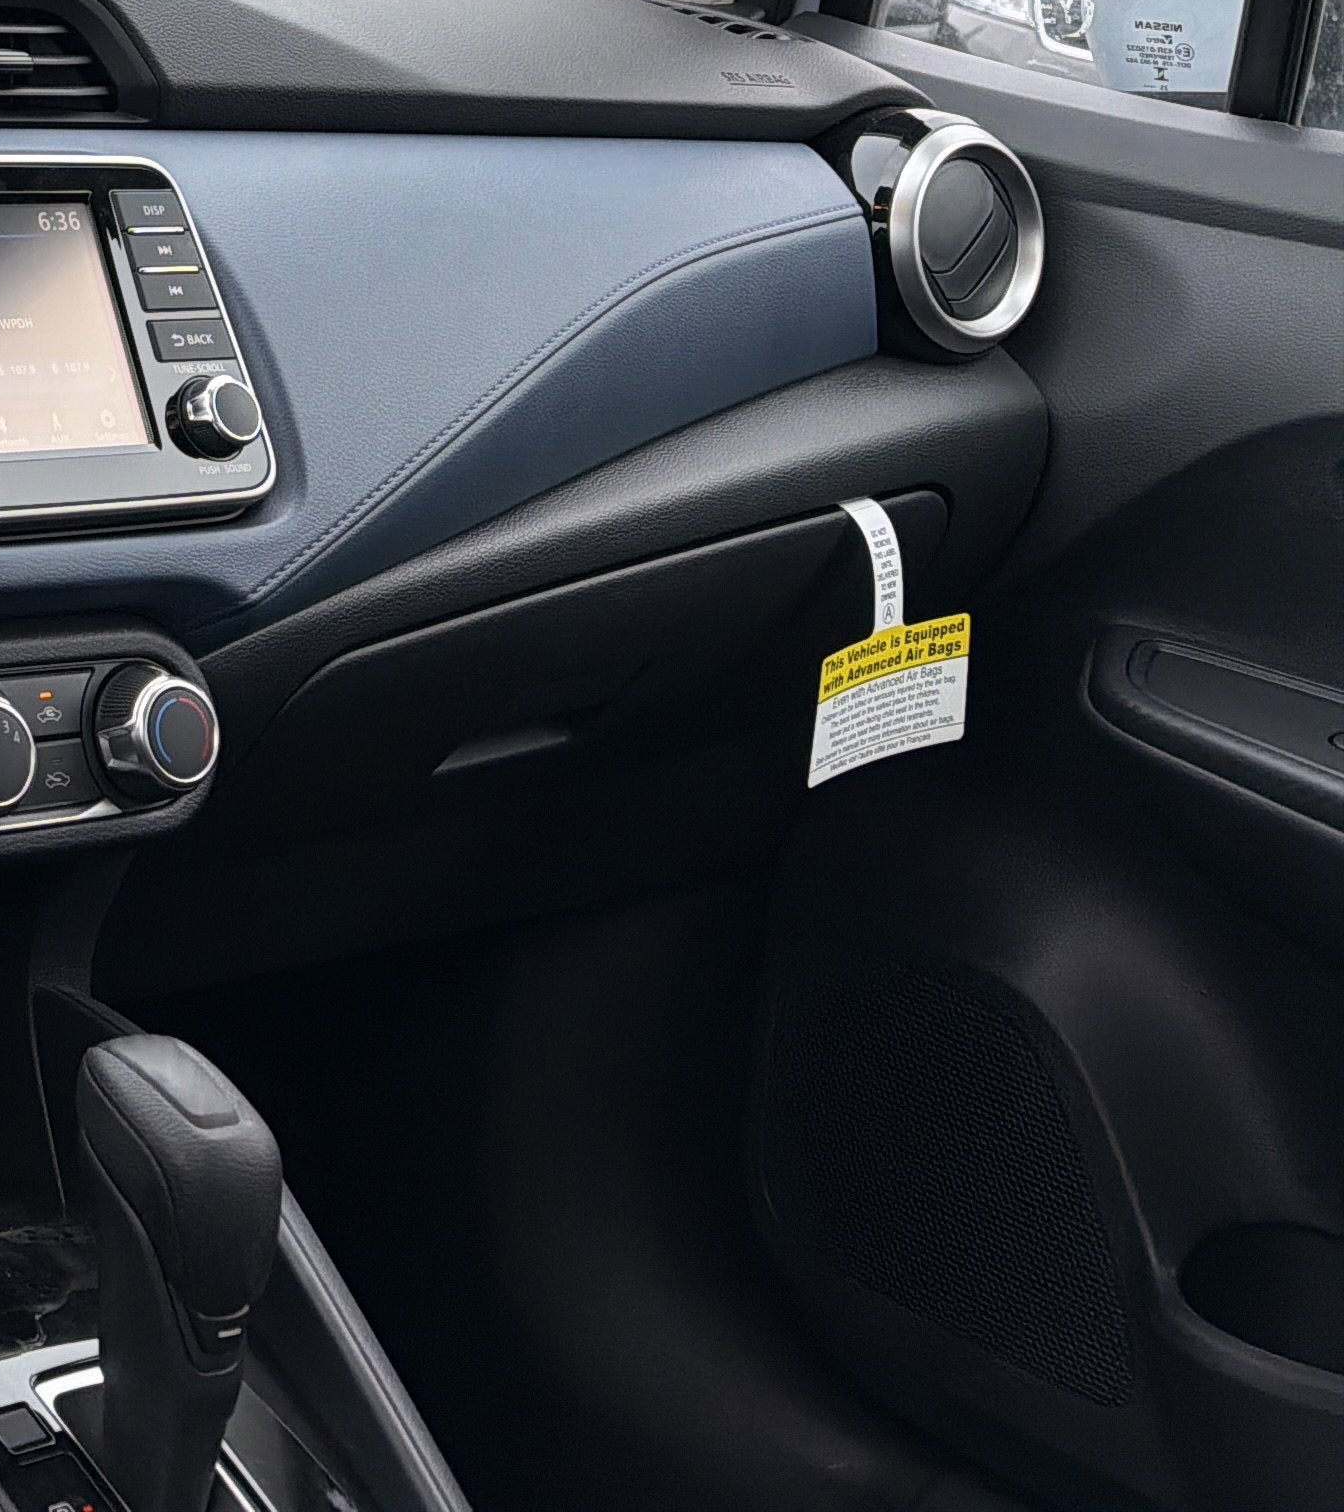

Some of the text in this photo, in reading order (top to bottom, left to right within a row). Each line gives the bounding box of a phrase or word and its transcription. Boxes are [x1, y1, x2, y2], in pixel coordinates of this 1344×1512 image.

[143, 205, 165, 216] DISP
[37, 211, 81, 232] 6:36
[0, 317, 33, 330] WPDH
[186, 334, 214, 345] BACK
[199, 463, 252, 476] PUSH SOUND
[824, 618, 965, 676] This Vehicle is Equipped
[823, 640, 962, 695] with Advanced Air Bags
[832, 665, 943, 709] Even with Advanced Air Bags
[2, 720, 10, 733] 3
[13, 731, 20, 743] 4
